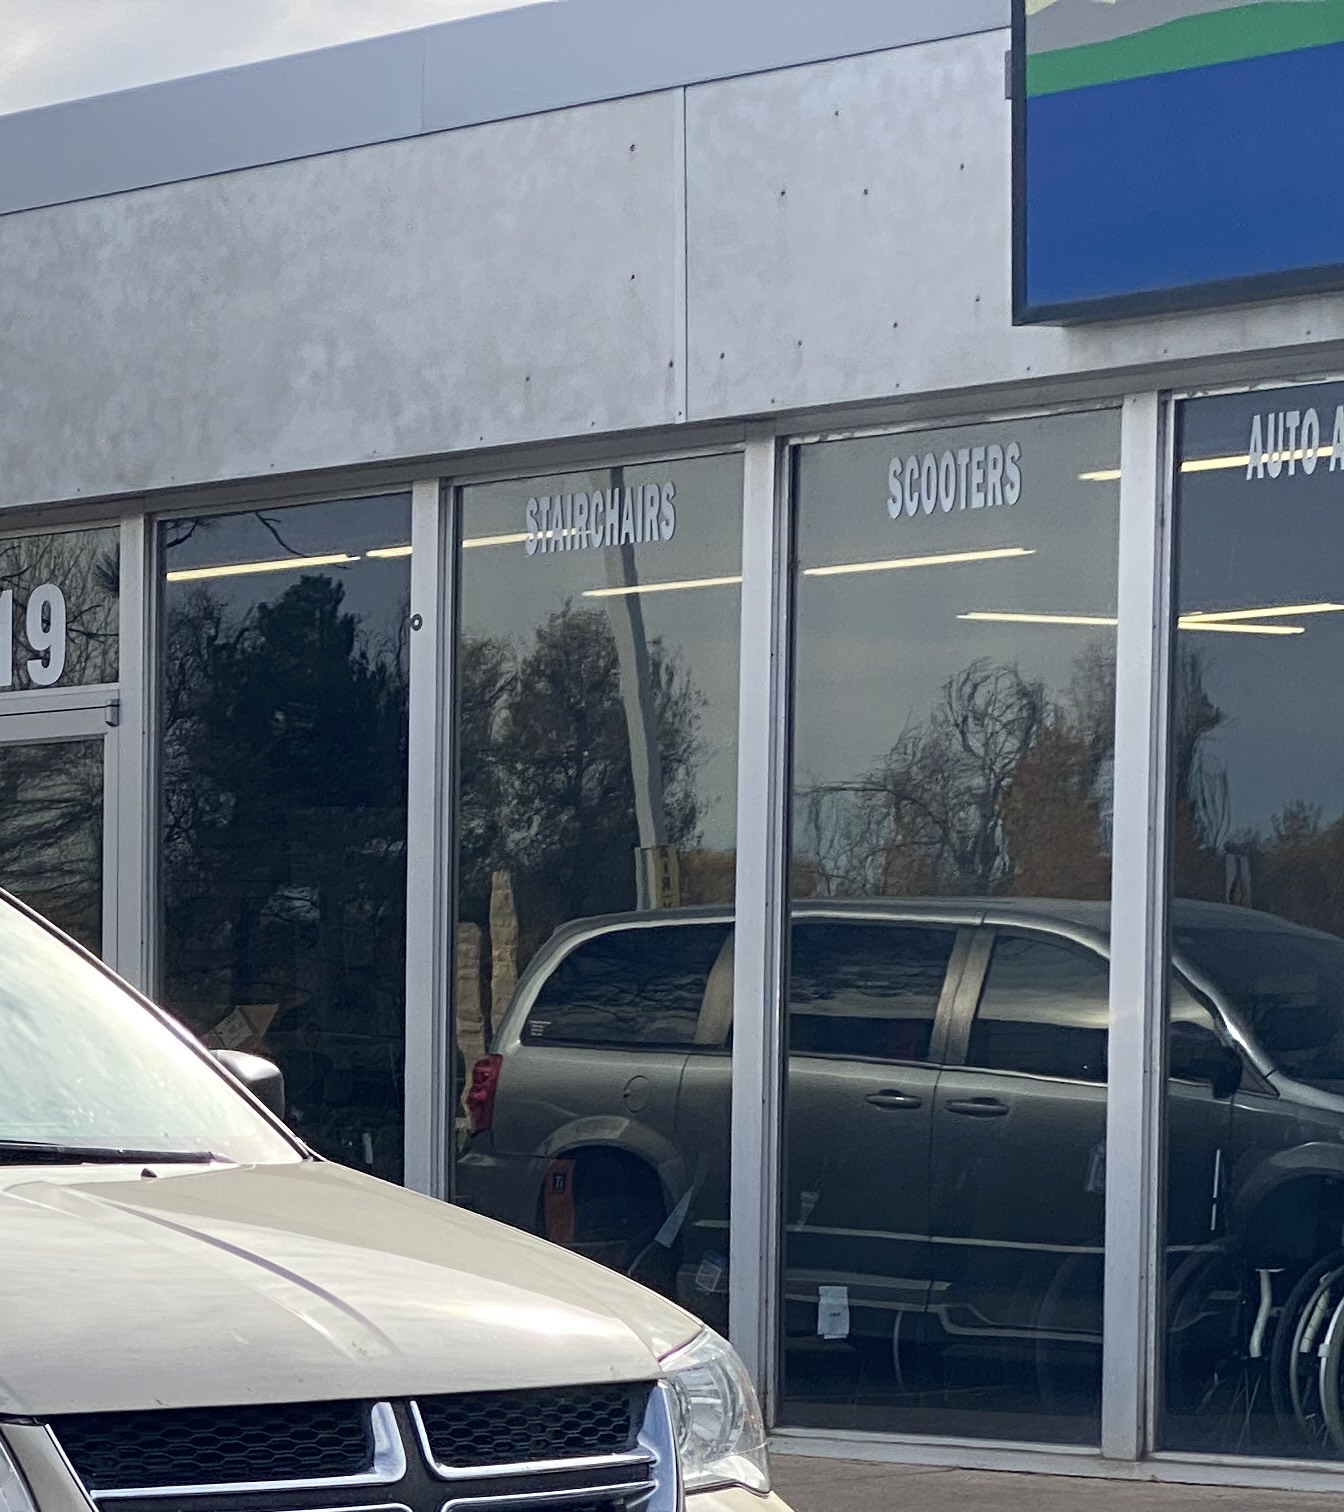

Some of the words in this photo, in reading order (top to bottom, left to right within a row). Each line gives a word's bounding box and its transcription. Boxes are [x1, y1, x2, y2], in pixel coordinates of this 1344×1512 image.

[887, 441, 1021, 519] SCOOTERS
[1246, 407, 1320, 480] AUTO
[525, 481, 676, 555] STAIRCHAIRS
